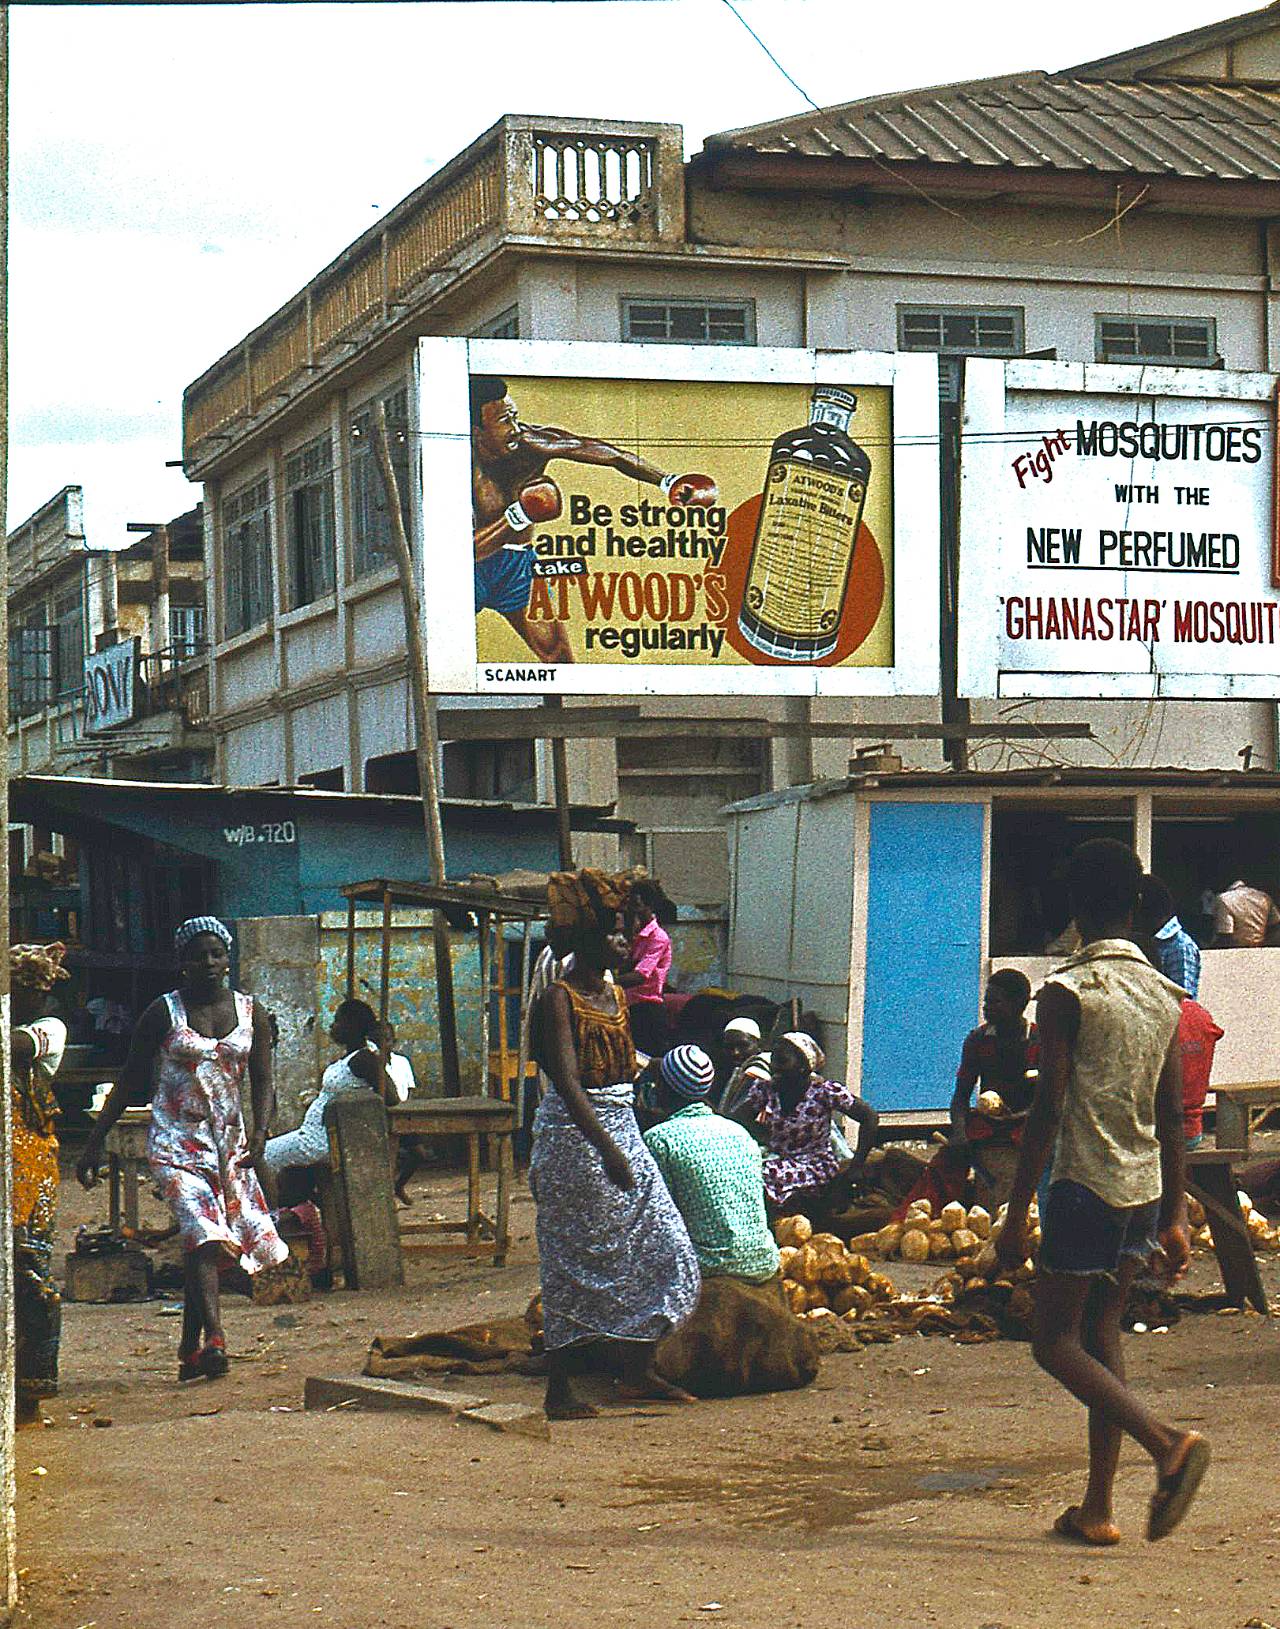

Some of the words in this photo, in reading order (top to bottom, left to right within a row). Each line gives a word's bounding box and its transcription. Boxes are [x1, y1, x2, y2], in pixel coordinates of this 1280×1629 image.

[1011, 428, 1071, 488] Fight
[1076, 420, 1262, 463] MOSQUITOES
[1115, 484, 1159, 504] WITH
[1174, 486, 1210, 505] THE
[569, 494, 613, 526] Be
[619, 498, 726, 536] strong
[536, 527, 596, 556] and
[606, 528, 726, 566] healthy
[1027, 527, 1082, 564] NEW
[1100, 530, 1240, 568] PERFUMED
[533, 560, 583, 575] take
[527, 571, 729, 623] ATWOOD'S
[585, 623, 725, 658] regularly
[485, 668, 557, 681] SCANART
